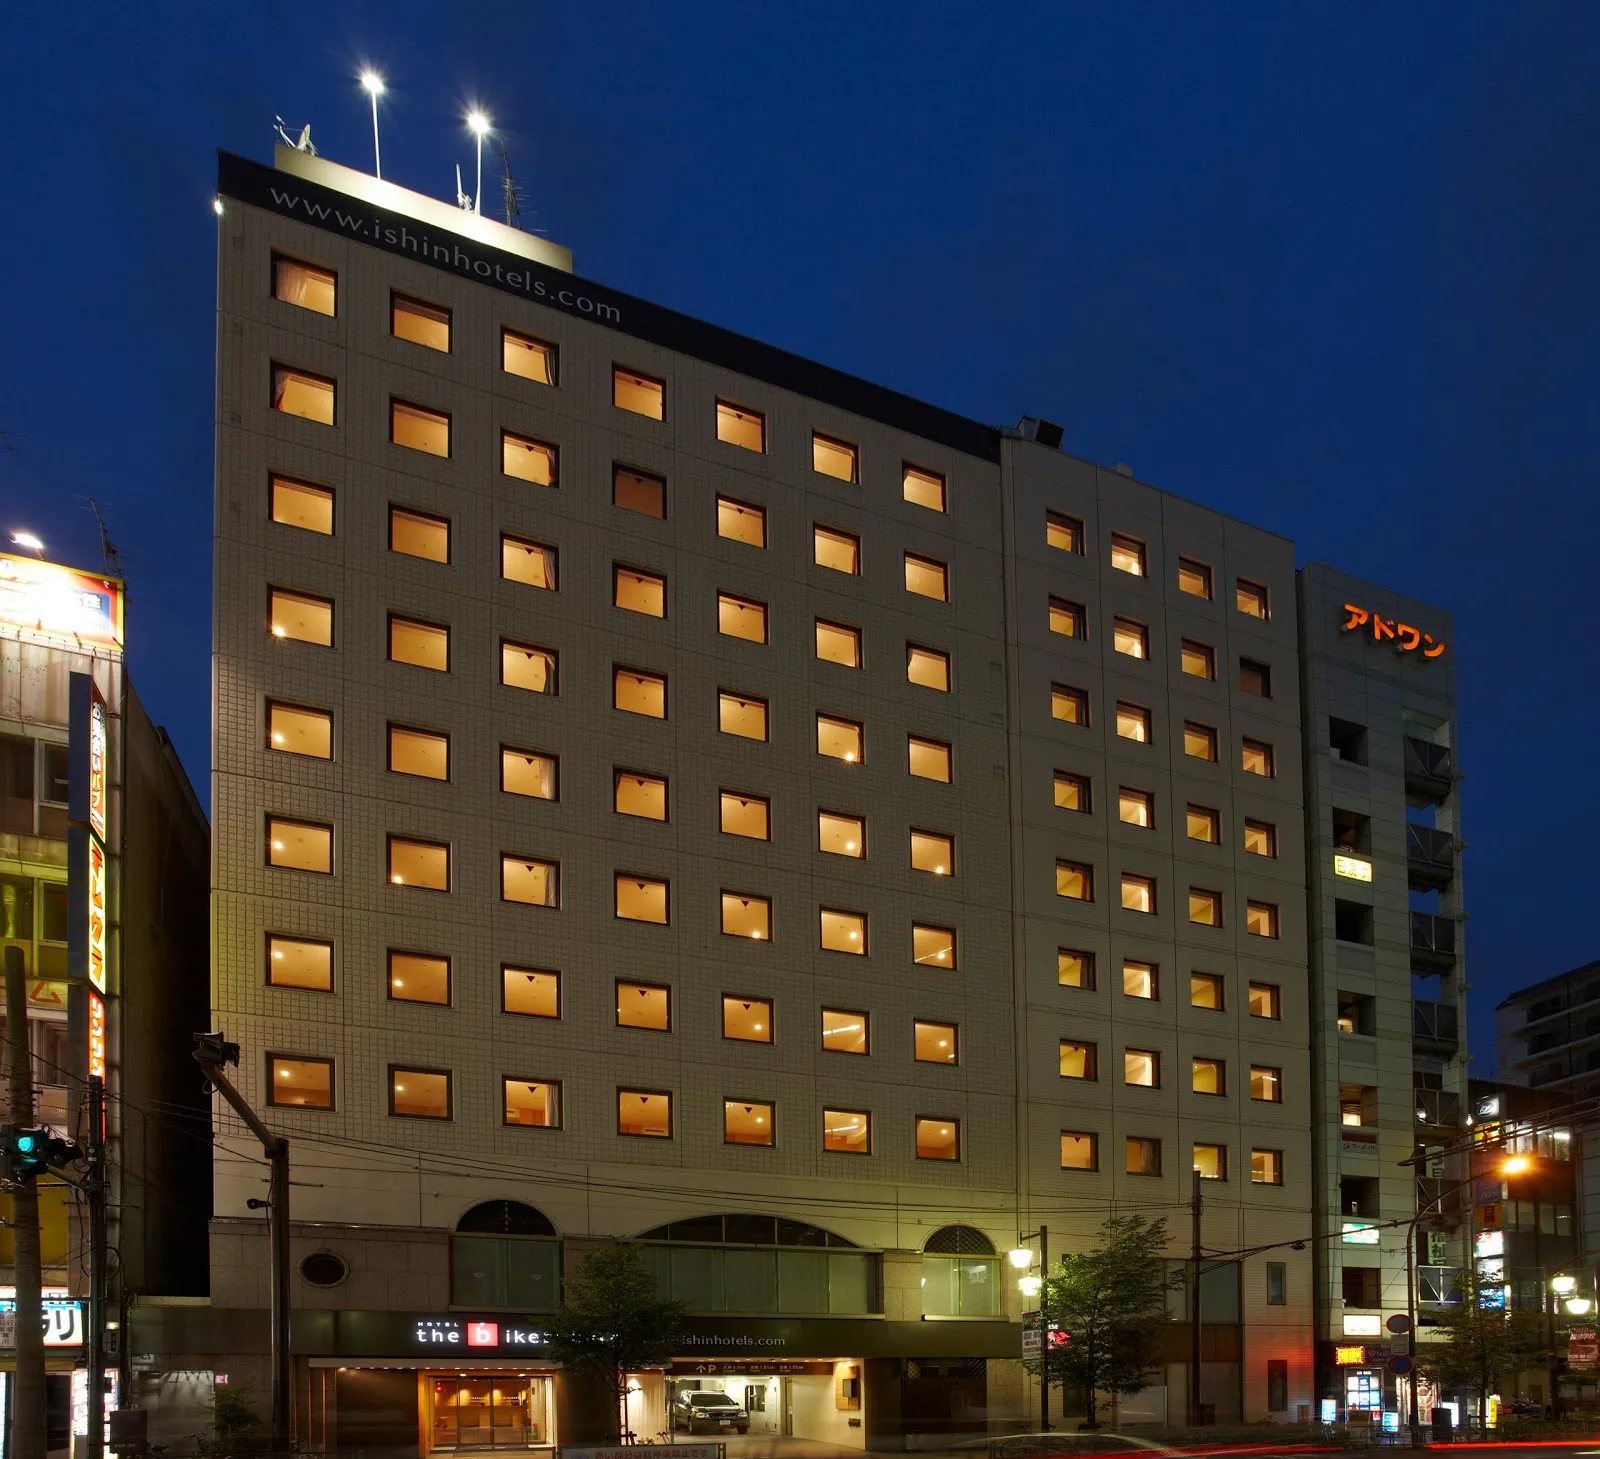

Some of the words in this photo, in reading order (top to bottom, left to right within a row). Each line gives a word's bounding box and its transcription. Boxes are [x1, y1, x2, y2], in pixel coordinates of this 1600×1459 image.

[270, 187, 621, 322] www.ishinhotels.com
[1344, 603, 1445, 657] アドワン
[416, 1328, 459, 1343] the
[643, 1335, 786, 1346] ishinhotels.com
[708, 1364, 717, 1374] P
